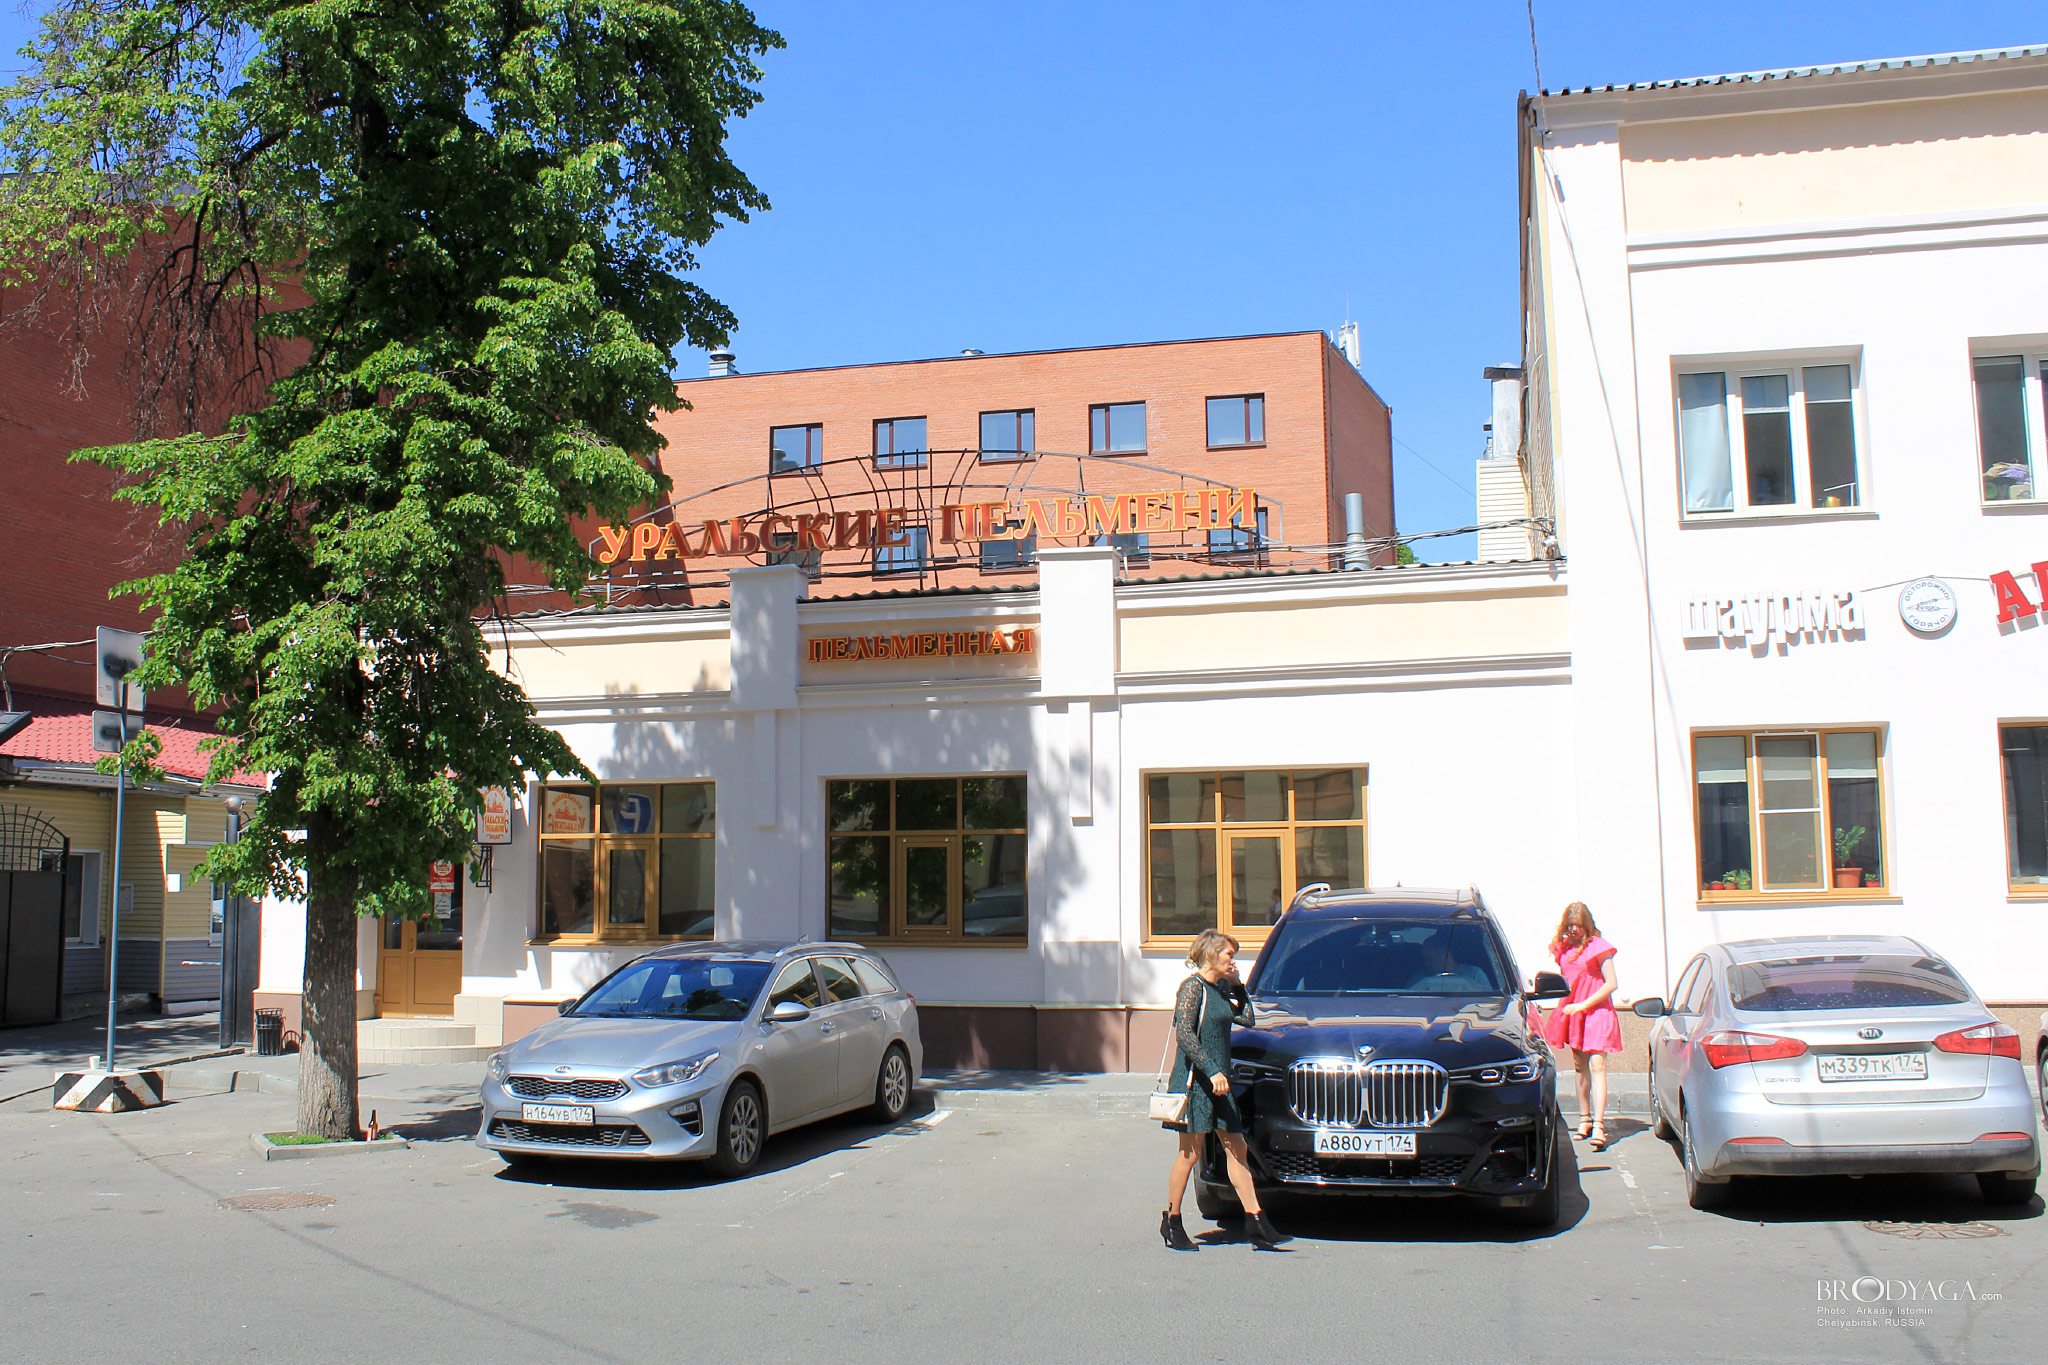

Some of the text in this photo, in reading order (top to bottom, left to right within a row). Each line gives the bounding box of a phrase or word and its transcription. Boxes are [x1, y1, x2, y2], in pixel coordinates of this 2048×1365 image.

[598, 487, 1257, 563] УРАЛЬСКИЕ ПЕЛЬМЕНИ
[1904, 581, 1951, 601] ОСТОРОЖНО!
[1680, 588, 1866, 647] шаурма
[1908, 614, 1949, 628] ГОРЯЧО!
[808, 628, 1034, 663] ПЕЛЬМЕННАЯ
[1860, 1029, 1881, 1038] KIA
[1824, 1054, 1920, 1074] М339ТК 174
[526, 1107, 591, 1121] Н164УВ 174
[1320, 1135, 1413, 1152] А880УТ 174
